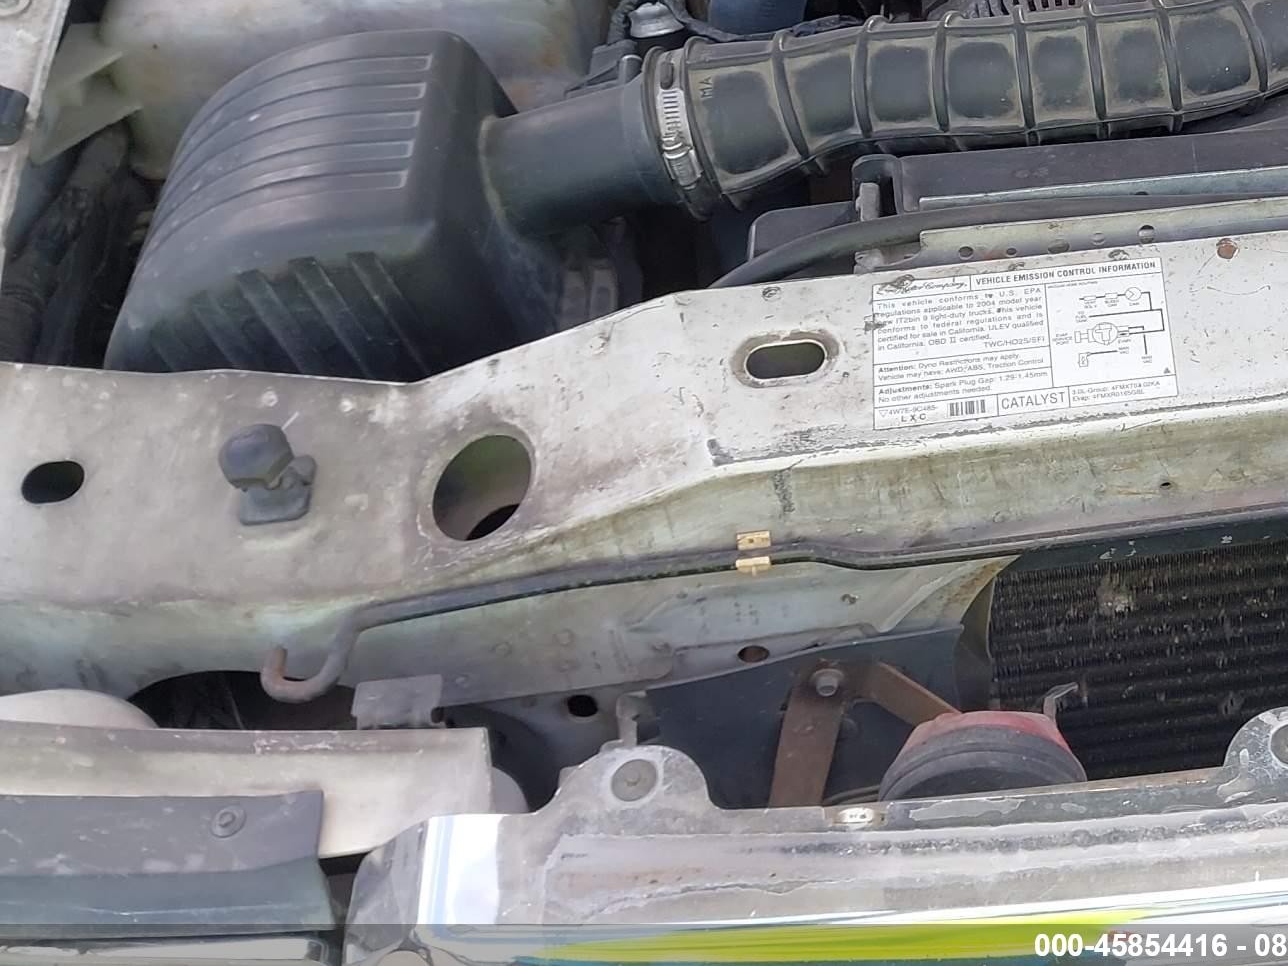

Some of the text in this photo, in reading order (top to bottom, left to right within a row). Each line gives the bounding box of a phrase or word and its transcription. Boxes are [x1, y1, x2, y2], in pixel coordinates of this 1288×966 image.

[976, 261, 1155, 285] VEHICLE EMISSION CONTROL INFORMATION
[938, 293, 978, 303] conforms
[1023, 287, 1041, 295] EPA
[1024, 295, 1041, 304] year
[930, 311, 965, 321] light-duty
[1015, 303, 1042, 312] vehicle
[933, 319, 961, 328] federal
[966, 315, 1011, 325] regulations
[877, 333, 907, 342] certified
[922, 330, 937, 338] sale
[1011, 319, 1043, 329] qualified
[877, 343, 884, 351] in
[928, 337, 946, 345] OBD
[906, 370, 921, 378] may
[878, 383, 932, 395] Adjustments:
[934, 380, 956, 389] Spark
[959, 378, 975, 387] Plug
[913, 388, 959, 400] adjustments
[1001, 391, 1065, 409] CATALYST
